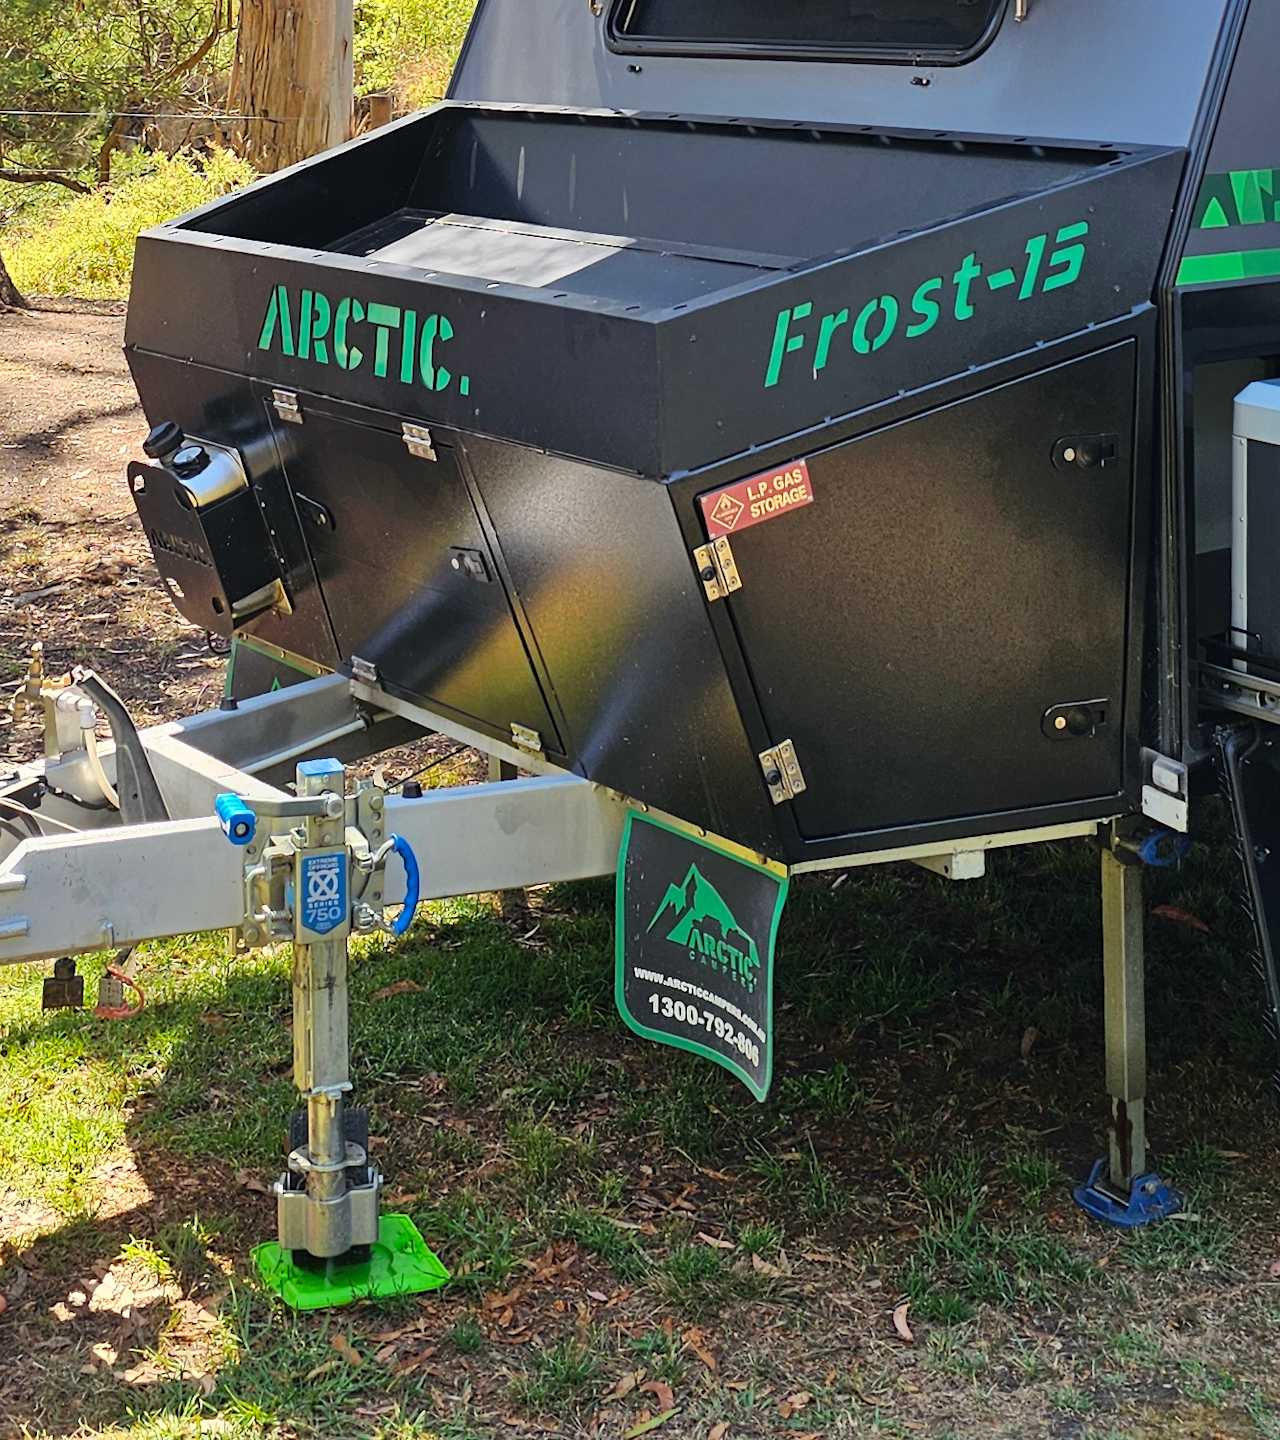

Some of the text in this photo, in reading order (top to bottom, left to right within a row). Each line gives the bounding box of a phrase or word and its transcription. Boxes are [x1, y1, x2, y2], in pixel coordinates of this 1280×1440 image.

[763, 221, 1090, 388] Frost-15
[773, 468, 803, 491] GAS
[750, 484, 808, 518] STORAGE
[306, 906, 341, 923] 750
[648, 992, 760, 1068] 1300-792-806
